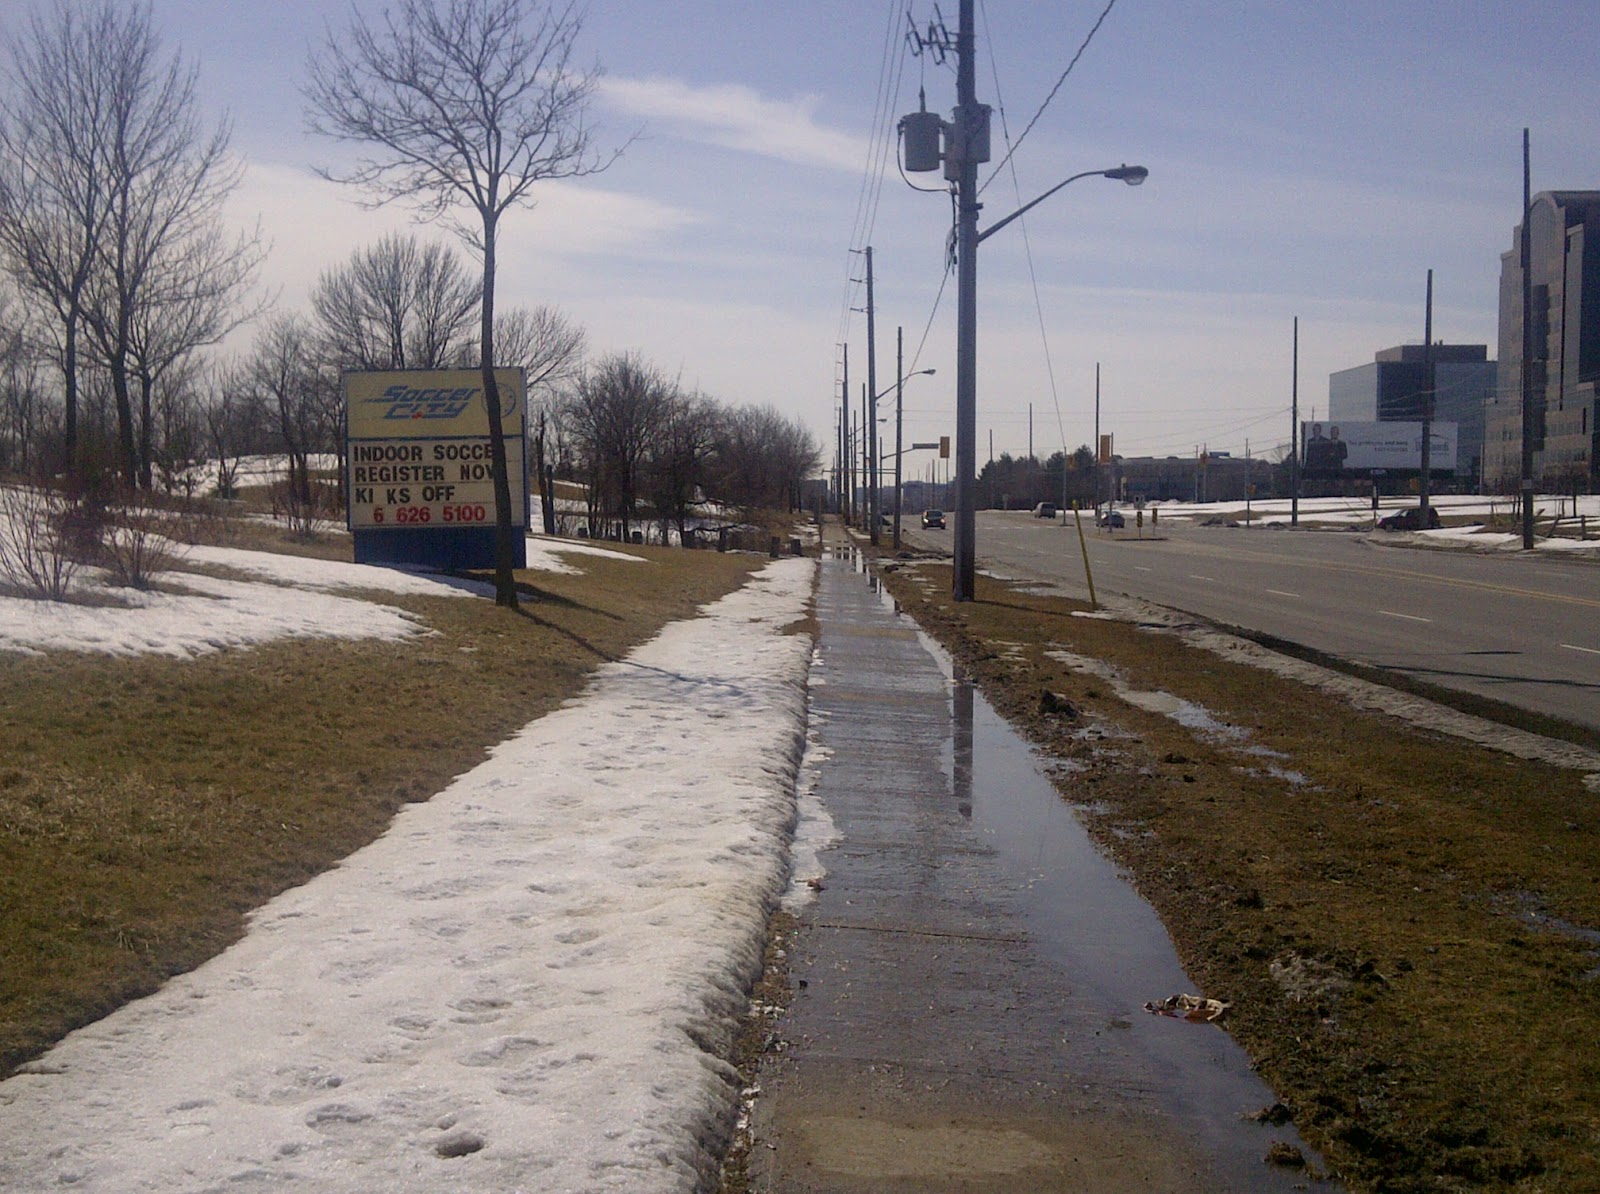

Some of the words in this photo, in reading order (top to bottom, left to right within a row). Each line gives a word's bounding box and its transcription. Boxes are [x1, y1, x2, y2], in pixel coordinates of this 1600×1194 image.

[354, 445, 423, 462] INDOOR
[433, 444, 494, 460] SOCCE
[355, 465, 445, 482] REGISTER
[422, 486, 455, 502] OFF
[373, 507, 384, 523] 6
[396, 506, 431, 523] 626
[443, 505, 486, 522] 5100
